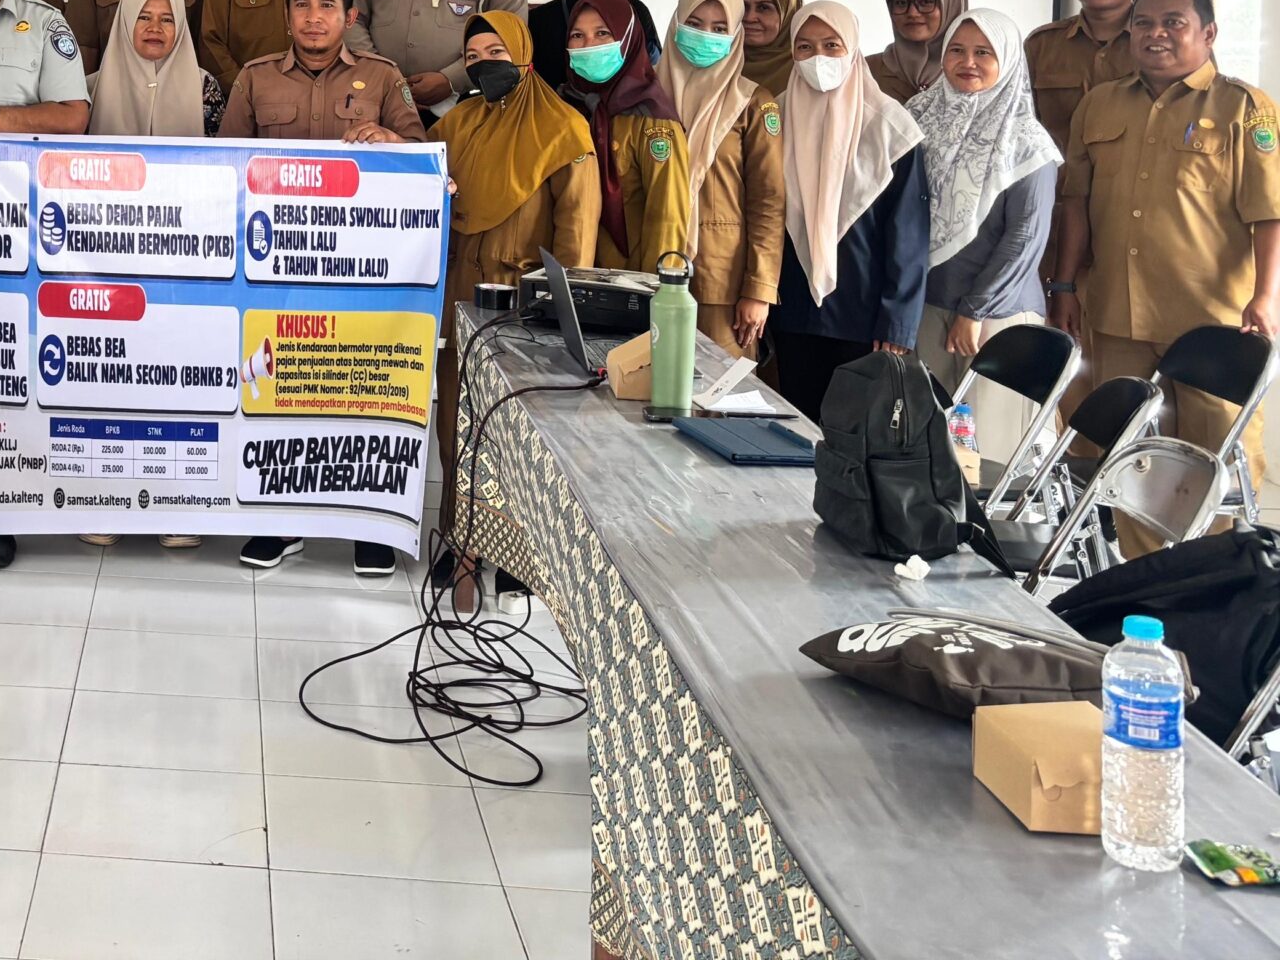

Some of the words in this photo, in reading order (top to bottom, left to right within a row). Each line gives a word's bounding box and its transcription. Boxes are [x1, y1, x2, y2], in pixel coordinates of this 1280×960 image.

[70, 158, 110, 181] GRATIS
[280, 163, 322, 187] GRATIS
[67, 203, 102, 225] BEBAS
[106, 204, 144, 227] DENDA
[147, 206, 182, 227] PAJAK
[274, 204, 307, 226] BEBAS
[311, 206, 346, 227] DENDA
[349, 207, 397, 228] SWDKLLJ
[401, 208, 440, 231] (UNTUK
[67, 230, 134, 254] KENDARAAN
[138, 233, 199, 256] BERMOTOR
[202, 234, 234, 260] (PKB)
[274, 230, 308, 251] TAHUN
[311, 231, 336, 252] LALU
[273, 255, 280, 275] &
[284, 256, 318, 276] TAHUN
[321, 257, 355, 277] TAHUN
[359, 258, 388, 279] LALU)
[70, 288, 110, 312] GRATIS
[276, 315, 327, 338] KHUSUS
[331, 315, 336, 338] !
[67, 335, 101, 357] BEBAS
[105, 337, 126, 358] BEA
[276, 342, 295, 352] Jenis
[297, 342, 337, 352] Kendaraan
[338, 343, 372, 353] bermotor
[373, 345, 392, 355] yang
[394, 343, 421, 355] dikenai
[276, 356, 296, 368] pajak
[298, 356, 334, 370] penjualan
[336, 357, 352, 366] atas
[353, 357, 380, 369] barang
[381, 358, 408, 369] mewah
[410, 359, 424, 371] dan
[67, 361, 98, 382] BALIK
[101, 363, 133, 384] NAMA
[136, 364, 177, 385] SECOND
[181, 365, 222, 388] (BBNKB
[226, 367, 238, 389] 2)
[276, 370, 311, 383] kapasitas
[322, 370, 349, 380] silinder
[350, 369, 367, 383] (CC)
[369, 372, 389, 381] besar
[275, 382, 302, 396] (sesuai
[303, 384, 318, 394] PMK
[320, 384, 344, 394] Nomor
[349, 384, 409, 400] 92/PMK.03/2019)
[275, 397, 293, 407] tidak
[295, 398, 346, 410] mendapatkan
[347, 401, 379, 411] program
[381, 401, 426, 416] pembebasan
[72, 425, 85, 433] Roda
[105, 426, 120, 434] BPKB
[148, 427, 162, 436] STNK
[190, 428, 204, 436] PLAT
[52, 444, 67, 452] RODA
[102, 445, 123, 454] 225.000
[143, 446, 166, 455] 100.000
[187, 447, 207, 456] 60.000
[243, 439, 304, 469] CUKUP
[305, 436, 366, 465] BAYAR
[366, 435, 422, 469] PAJAK
[18, 454, 47, 473] (PNBP)
[52, 463, 67, 471] RODA
[102, 465, 123, 473] 375.000
[143, 465, 166, 474] 200.000
[185, 466, 208, 475] 100.000
[259, 465, 319, 495] TAHUN
[319, 464, 408, 495] BERJALAN
[67, 494, 131, 509] samsat.kalteng
[153, 495, 230, 507] samsatkalteng.com
